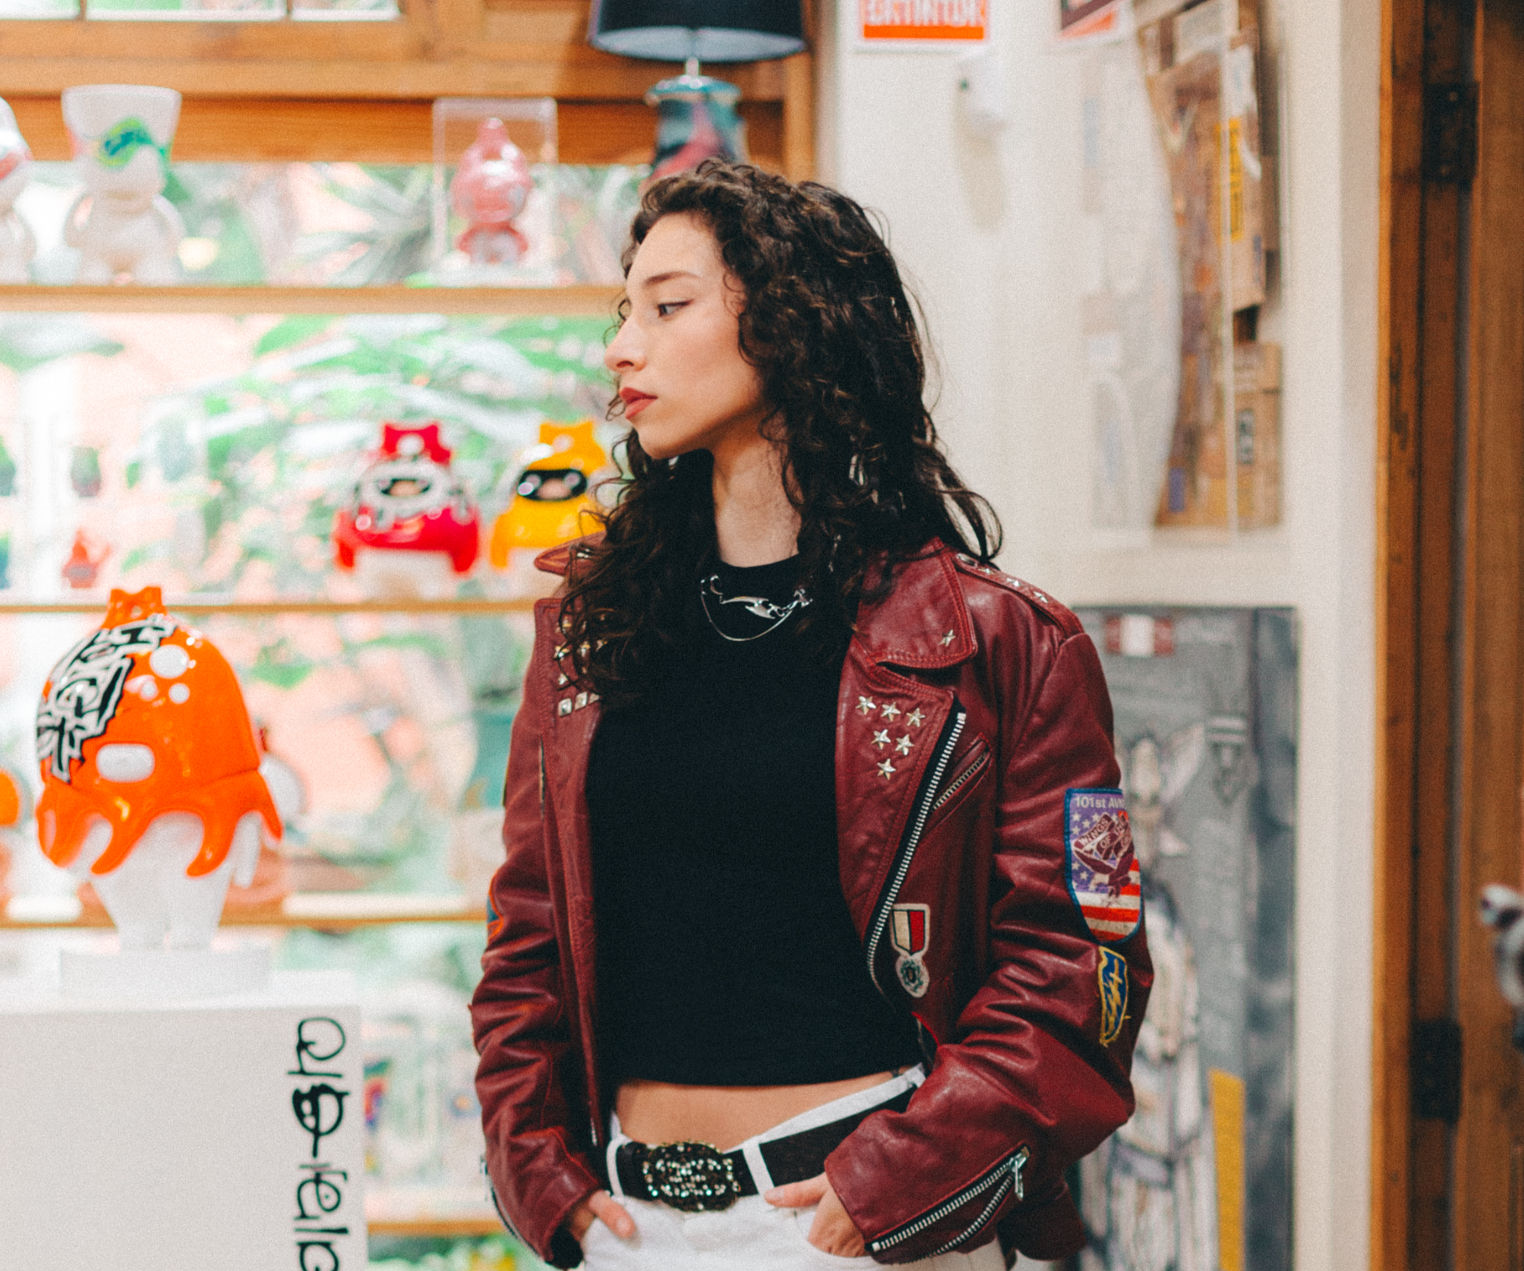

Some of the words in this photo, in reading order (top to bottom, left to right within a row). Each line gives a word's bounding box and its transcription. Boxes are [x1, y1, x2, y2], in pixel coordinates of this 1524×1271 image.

[1074, 796, 1106, 809] 101st
[1079, 817, 1109, 846] WINGS
[1100, 834, 1112, 849] OF
